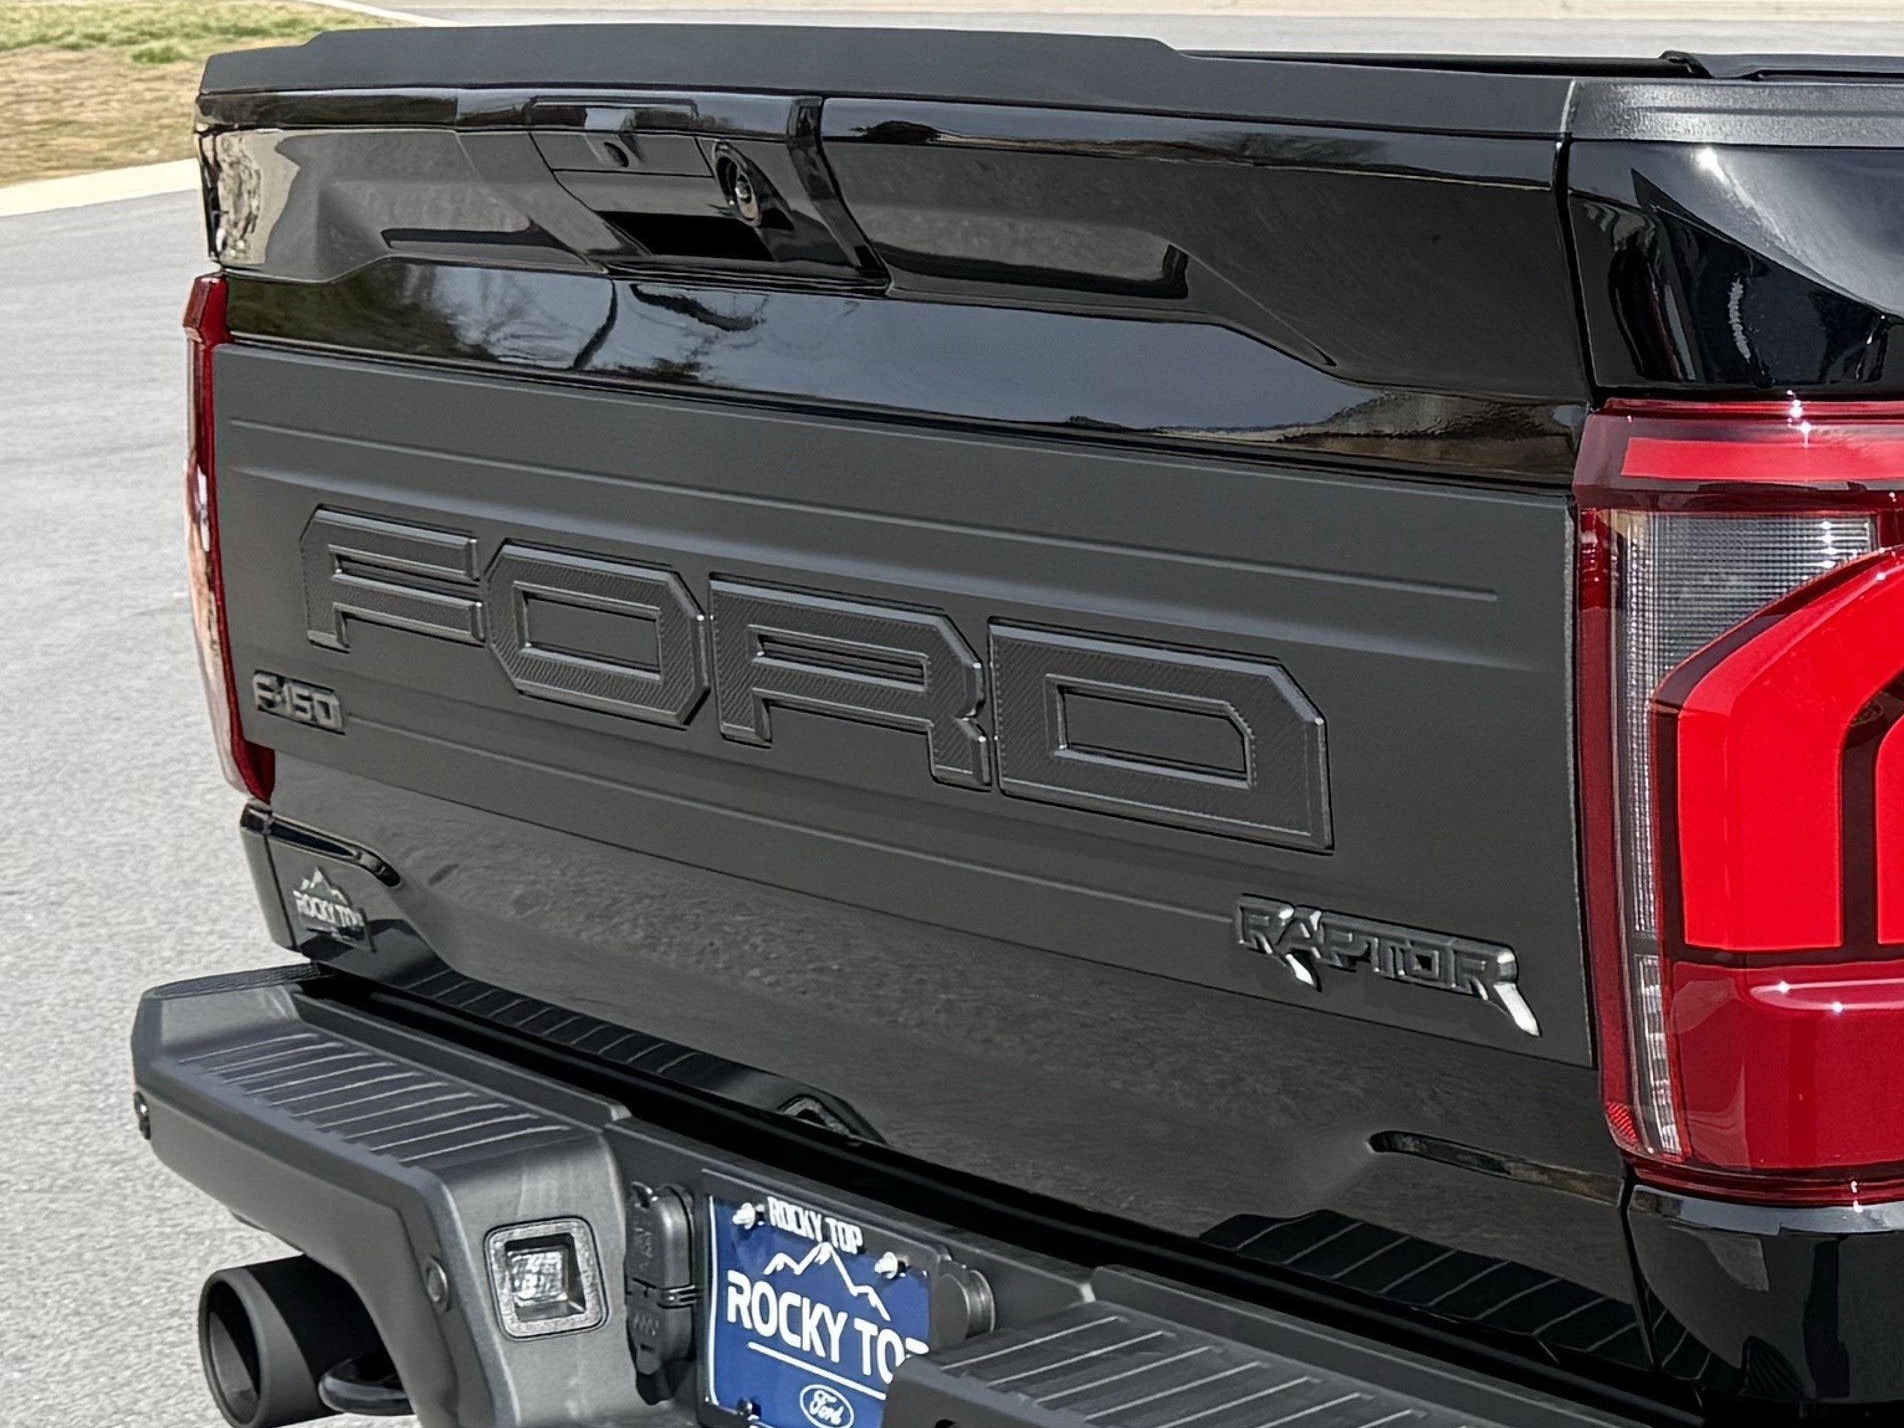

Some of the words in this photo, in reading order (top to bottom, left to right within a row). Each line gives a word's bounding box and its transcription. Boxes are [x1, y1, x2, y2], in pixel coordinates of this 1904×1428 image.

[252, 669, 343, 732] F-150
[300, 503, 1333, 854] FORD
[1234, 894, 1540, 1037] RAPTOR
[767, 1196, 822, 1242] ROCKY
[824, 1217, 863, 1254] TOP
[727, 1270, 848, 1363] ROCKY
[853, 1317, 930, 1384] TO
[809, 1389, 845, 1425] Ford
